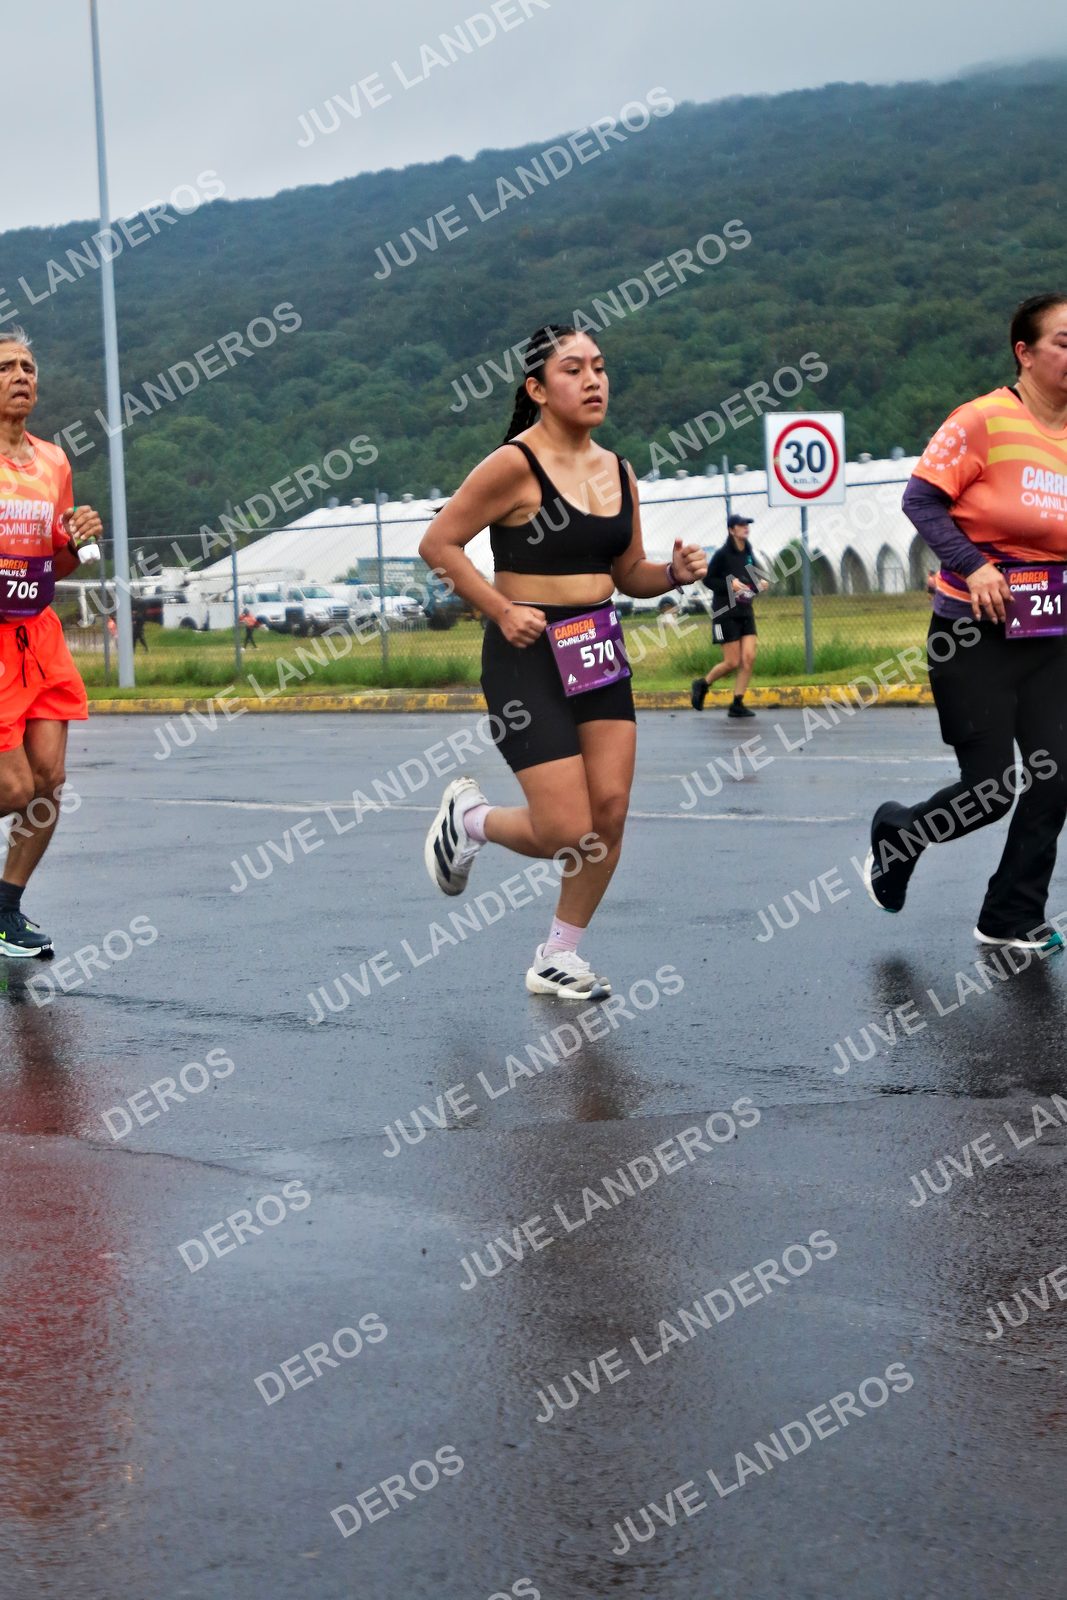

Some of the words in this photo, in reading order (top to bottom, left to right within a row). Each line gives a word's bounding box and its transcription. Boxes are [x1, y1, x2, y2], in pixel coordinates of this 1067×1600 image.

[785, 440, 826, 473] 30
[0, 499, 54, 521] CARRERA
[1010, 571, 1049, 585] CARRERA
[6, 580, 39, 599] 706
[1030, 594, 1062, 616] 241
[554, 618, 596, 641] CARRERA
[580, 639, 615, 669] 570
